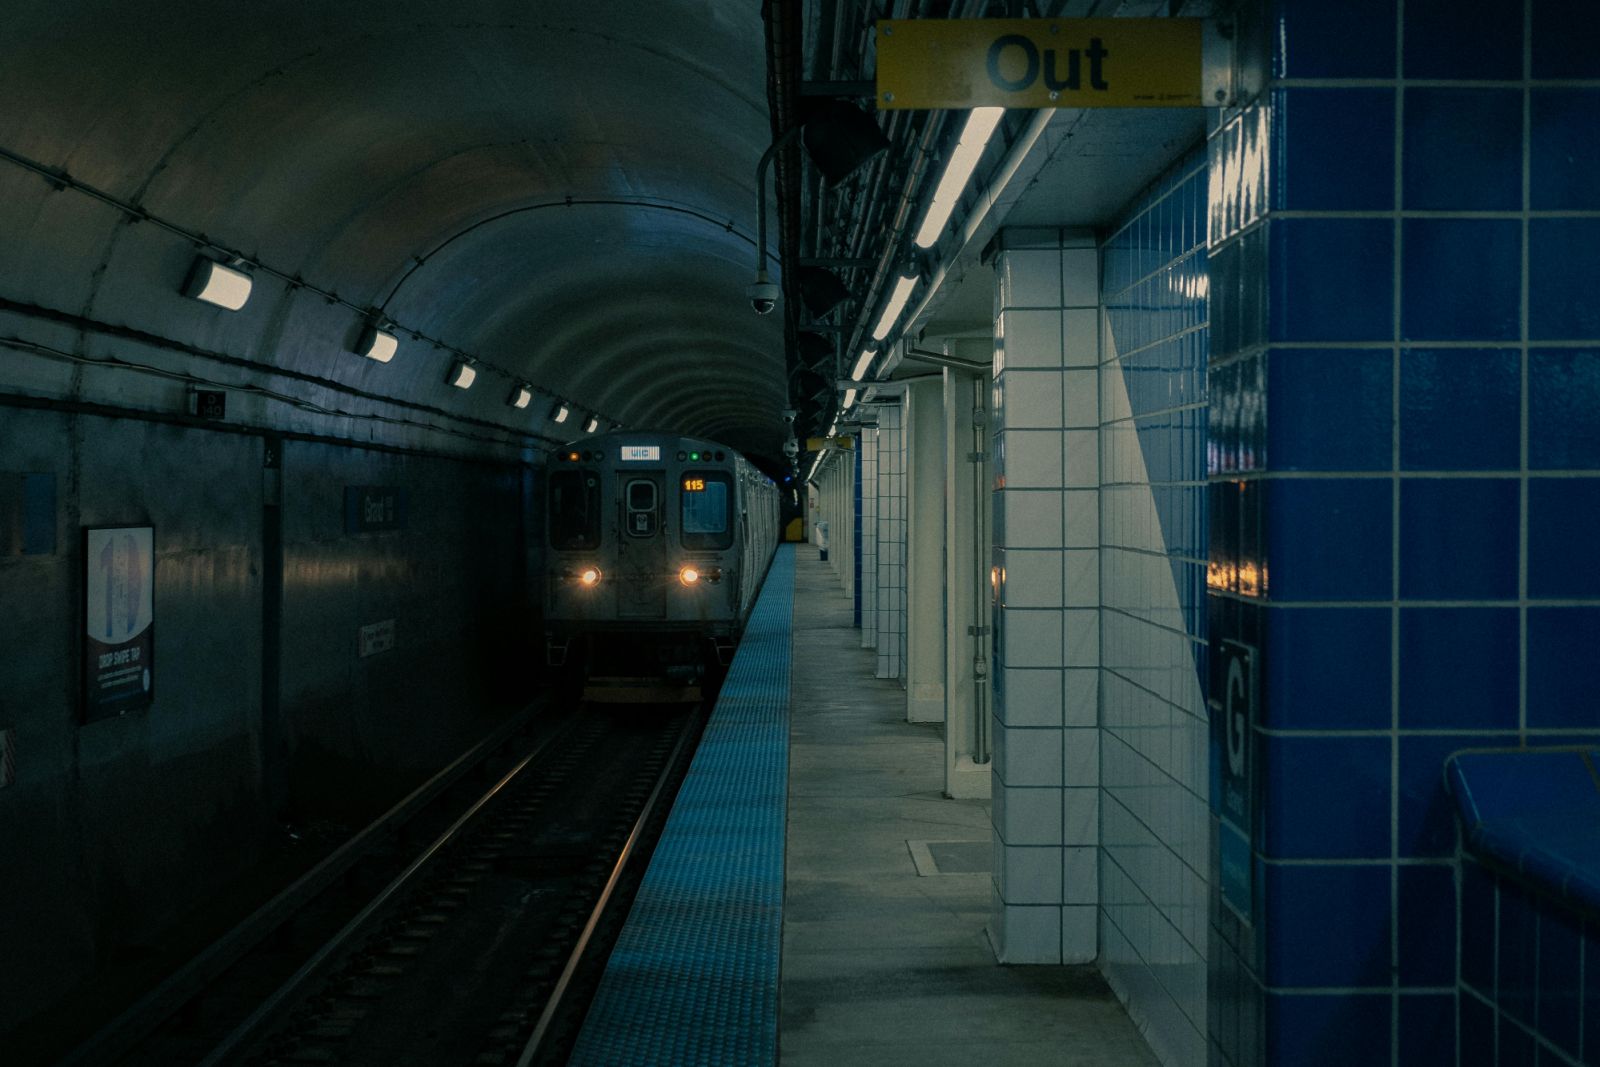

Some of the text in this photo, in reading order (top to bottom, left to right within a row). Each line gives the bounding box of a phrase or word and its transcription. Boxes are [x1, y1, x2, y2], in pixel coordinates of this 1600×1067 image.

[987, 34, 1108, 92] Out
[684, 479, 704, 491] 115
[1226, 655, 1245, 778] G
